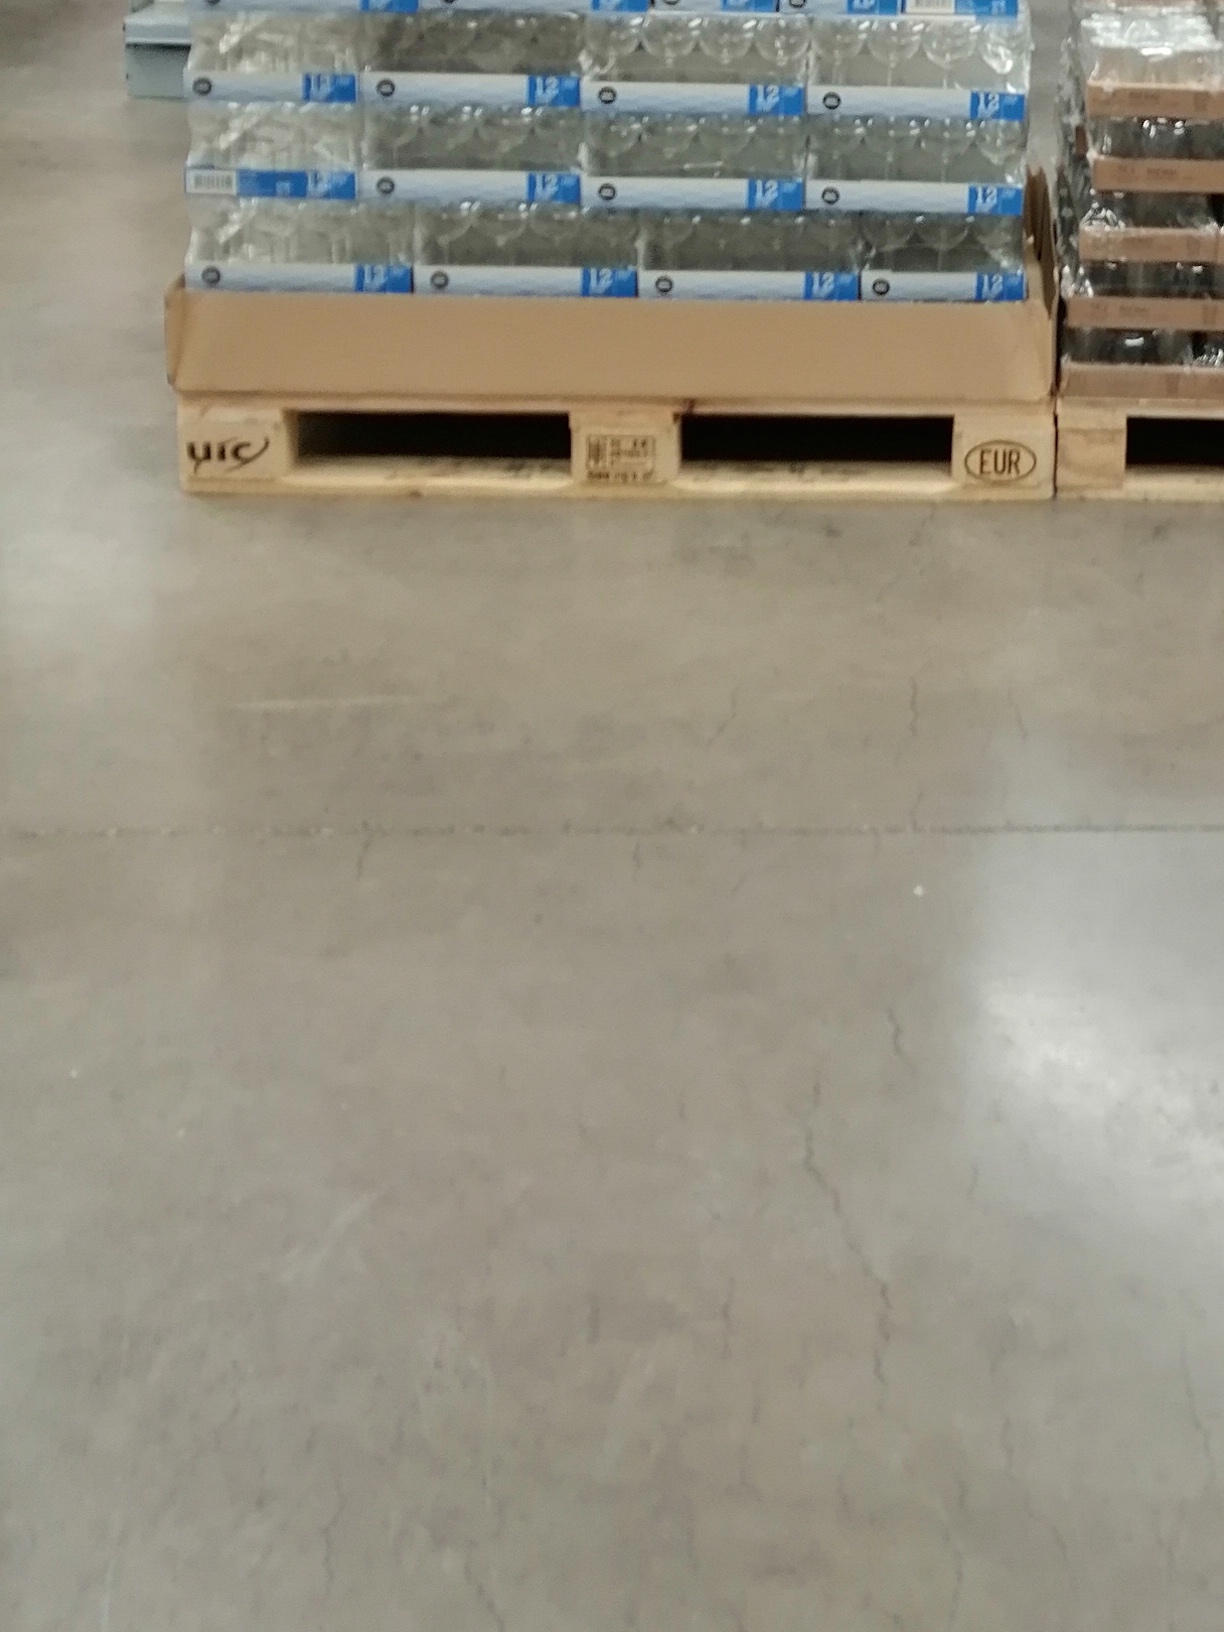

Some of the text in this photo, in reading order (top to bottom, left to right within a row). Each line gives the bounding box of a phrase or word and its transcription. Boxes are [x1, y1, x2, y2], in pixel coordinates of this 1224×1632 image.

[757, 84, 779, 105] 12
[979, 92, 999, 113] 12
[756, 179, 778, 200] 12
[813, 271, 835, 292] 12
[980, 449, 1021, 476] EUR
